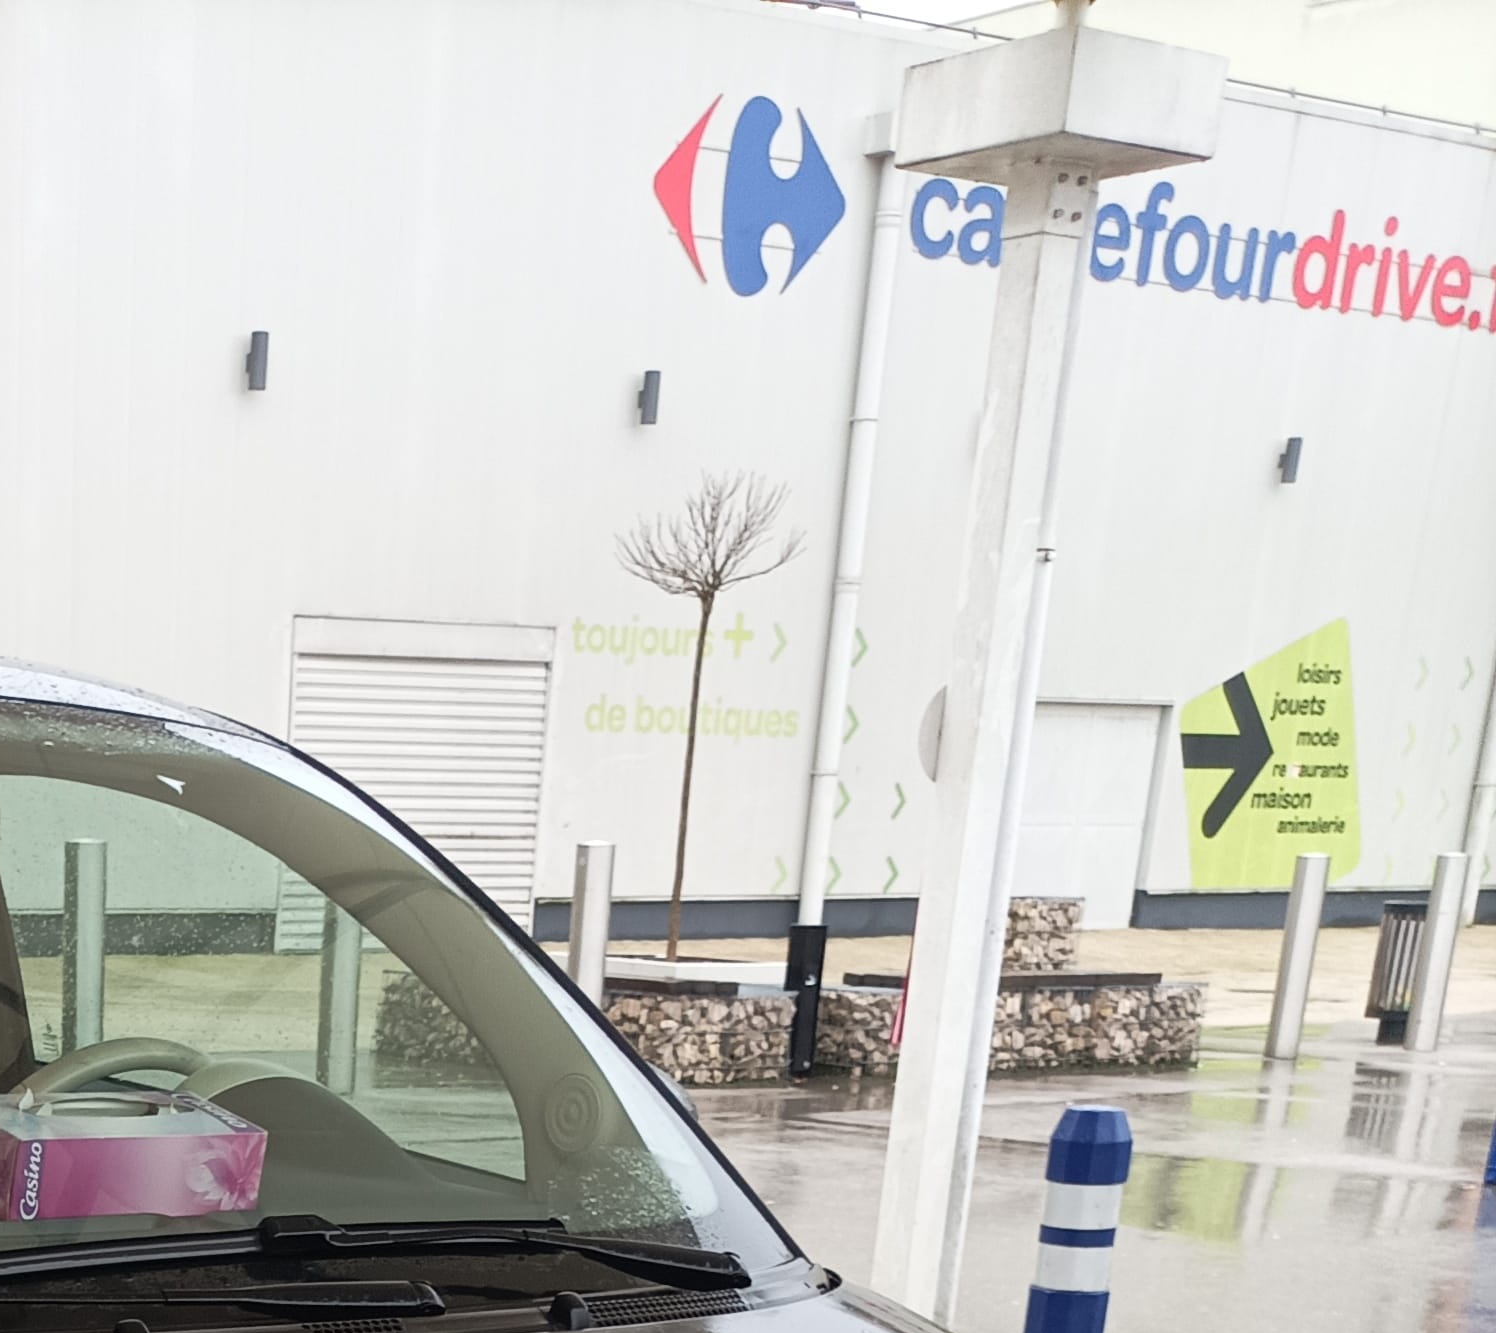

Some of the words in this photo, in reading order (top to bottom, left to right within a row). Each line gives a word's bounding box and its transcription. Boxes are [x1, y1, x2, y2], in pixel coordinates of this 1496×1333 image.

[1297, 662, 1342, 685] loisirs
[1270, 692, 1326, 721] jouets
[585, 693, 626, 732] de
[634, 696, 798, 746] boutiques
[1296, 727, 1340, 747] mode
[1272, 762, 1349, 778] reaurants
[1250, 786, 1312, 808] maison
[1276, 815, 1346, 834] animalerie
[19, 1141, 43, 1221] Casino
